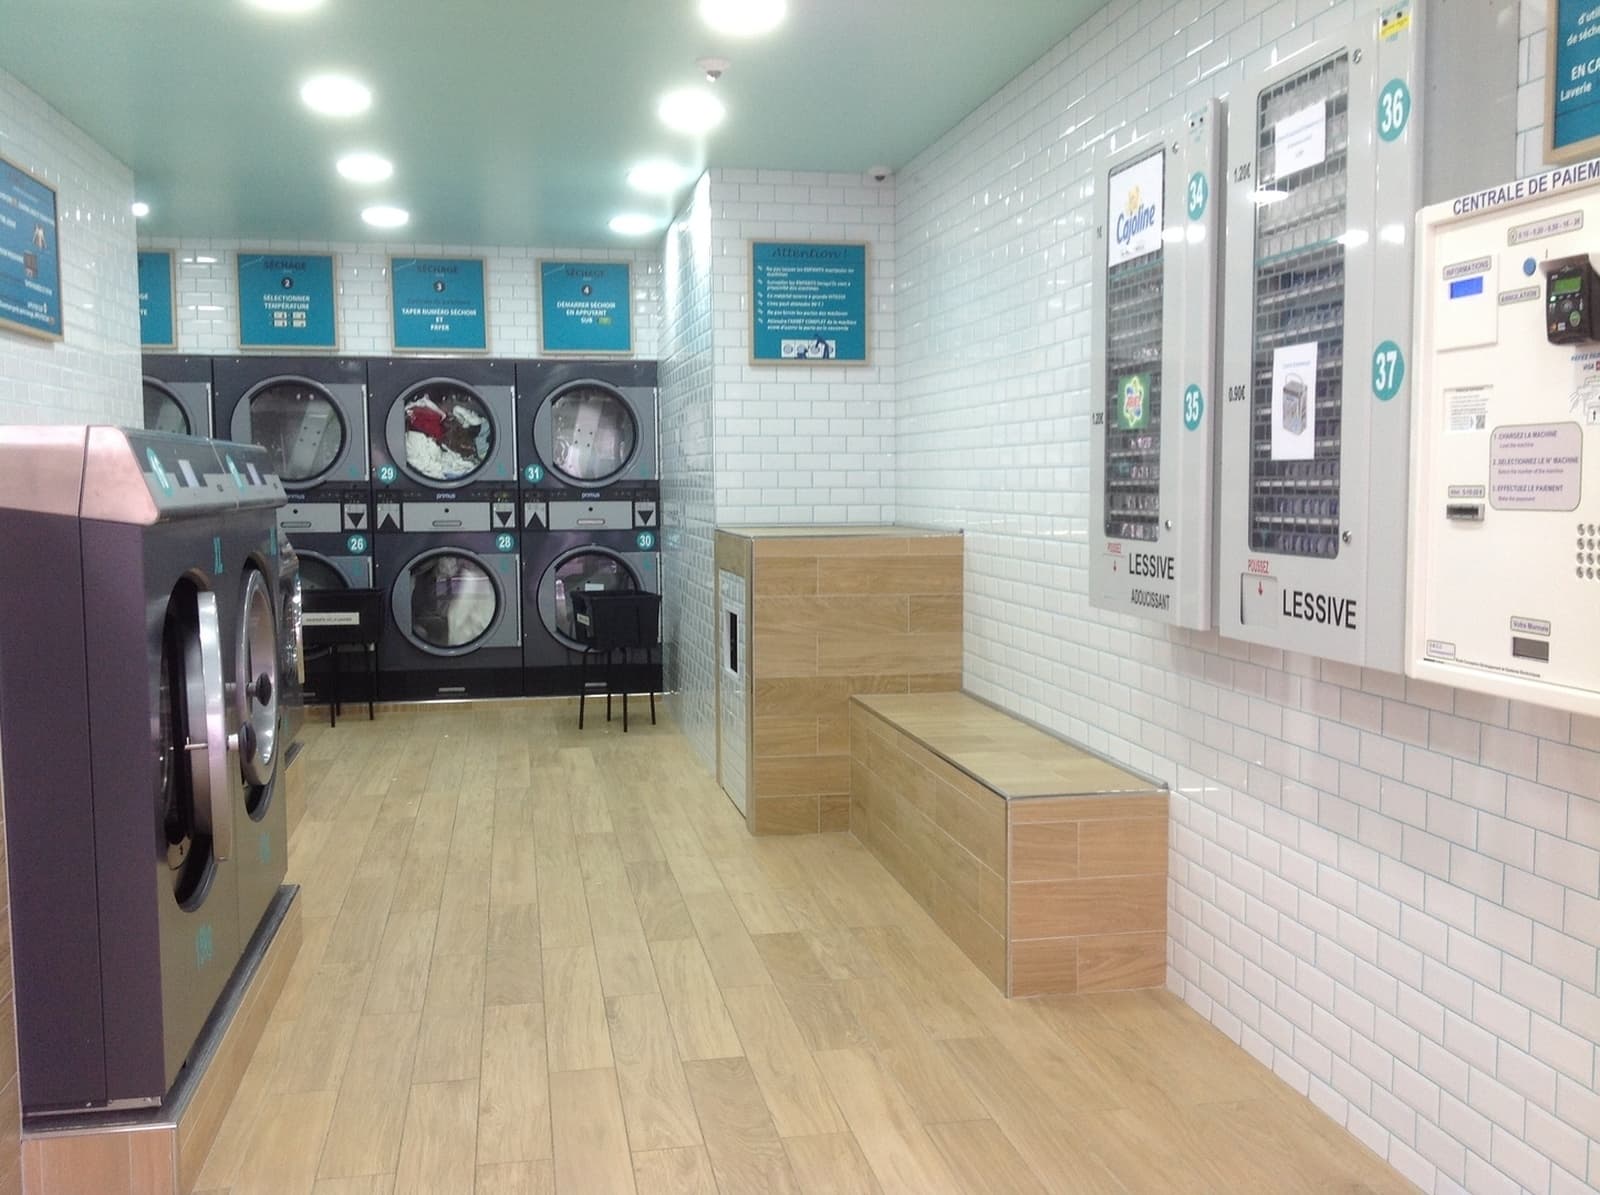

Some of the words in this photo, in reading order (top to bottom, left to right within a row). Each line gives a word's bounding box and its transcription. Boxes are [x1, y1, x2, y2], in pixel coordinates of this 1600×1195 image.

[1571, 62, 1586, 81] EN
[1560, 81, 1593, 102] Laverie
[1381, 88, 1404, 133] 36
[1189, 176, 1204, 212] 34
[1453, 181, 1524, 216] CENTRALE
[1528, 174, 1548, 196] DE
[285, 278, 291, 288] 2
[584, 286, 590, 295] 4
[1375, 350, 1398, 391] 37
[1185, 391, 1200, 423] 35
[381, 467, 394, 480] 29
[527, 467, 540, 479] 31
[350, 537, 364, 550] 26
[498, 536, 511, 548] 28
[639, 535, 651, 547] 30
[1128, 553, 1175, 580] LESSIVE
[1247, 559, 1269, 575] POUSSEZ
[1130, 588, 1170, 611] ADOUCISSANT
[1282, 588, 1357, 630] LESSIVE
